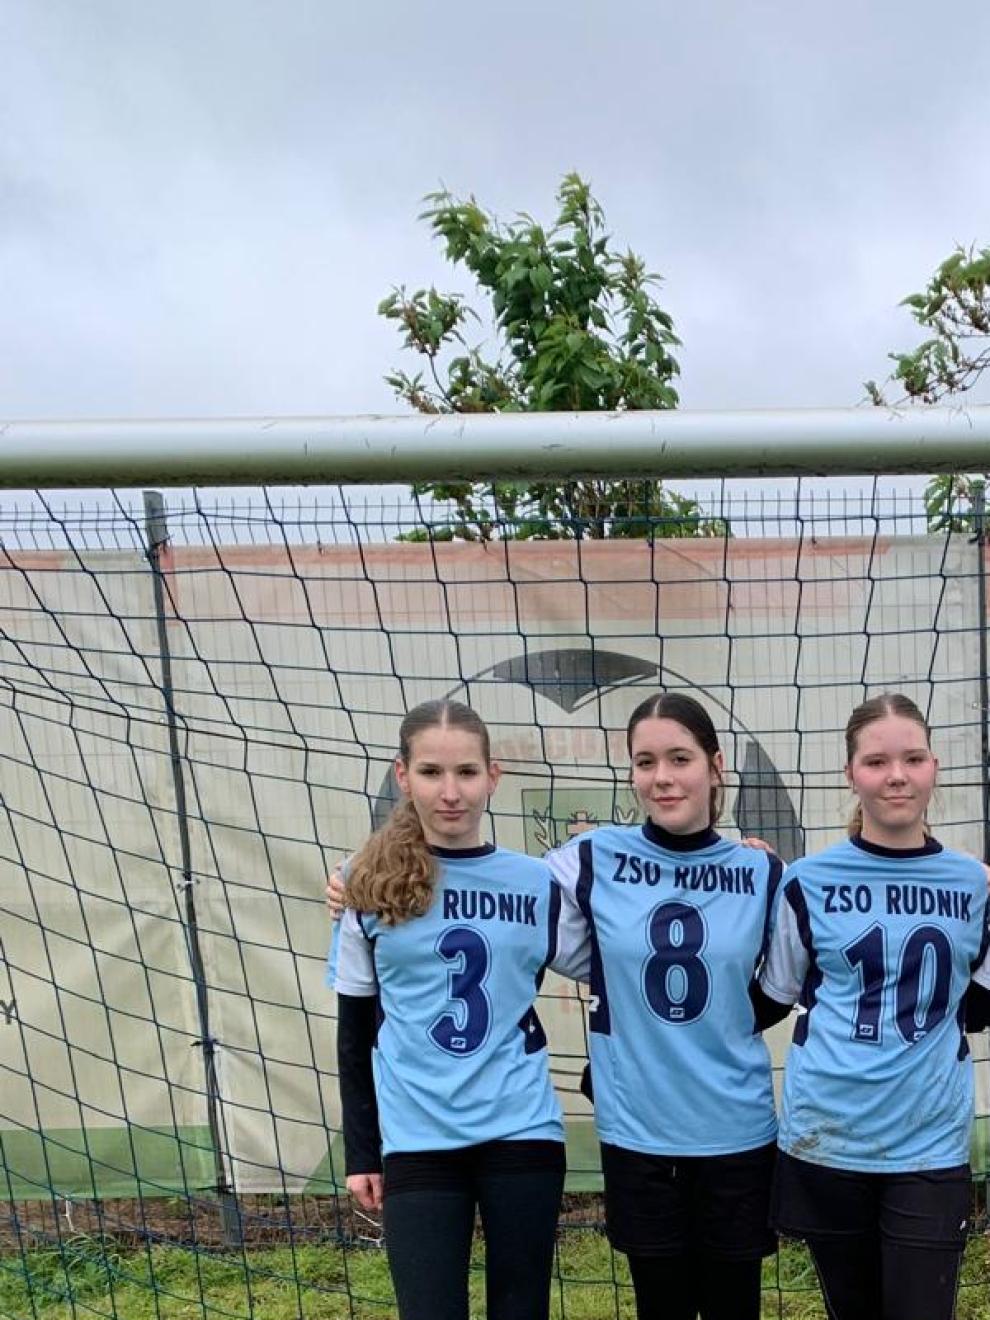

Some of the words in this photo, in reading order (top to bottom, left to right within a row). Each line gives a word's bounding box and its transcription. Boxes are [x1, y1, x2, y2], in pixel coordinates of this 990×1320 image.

[443, 888, 537, 926] RUDNIK
[612, 852, 661, 887] ZSO
[673, 862, 757, 897] RUDNIK
[821, 884, 873, 914] ZSO
[885, 885, 973, 922] RUDNIK
[426, 922, 493, 1058] 3
[639, 899, 712, 1026] 8
[840, 920, 955, 1046] 10
